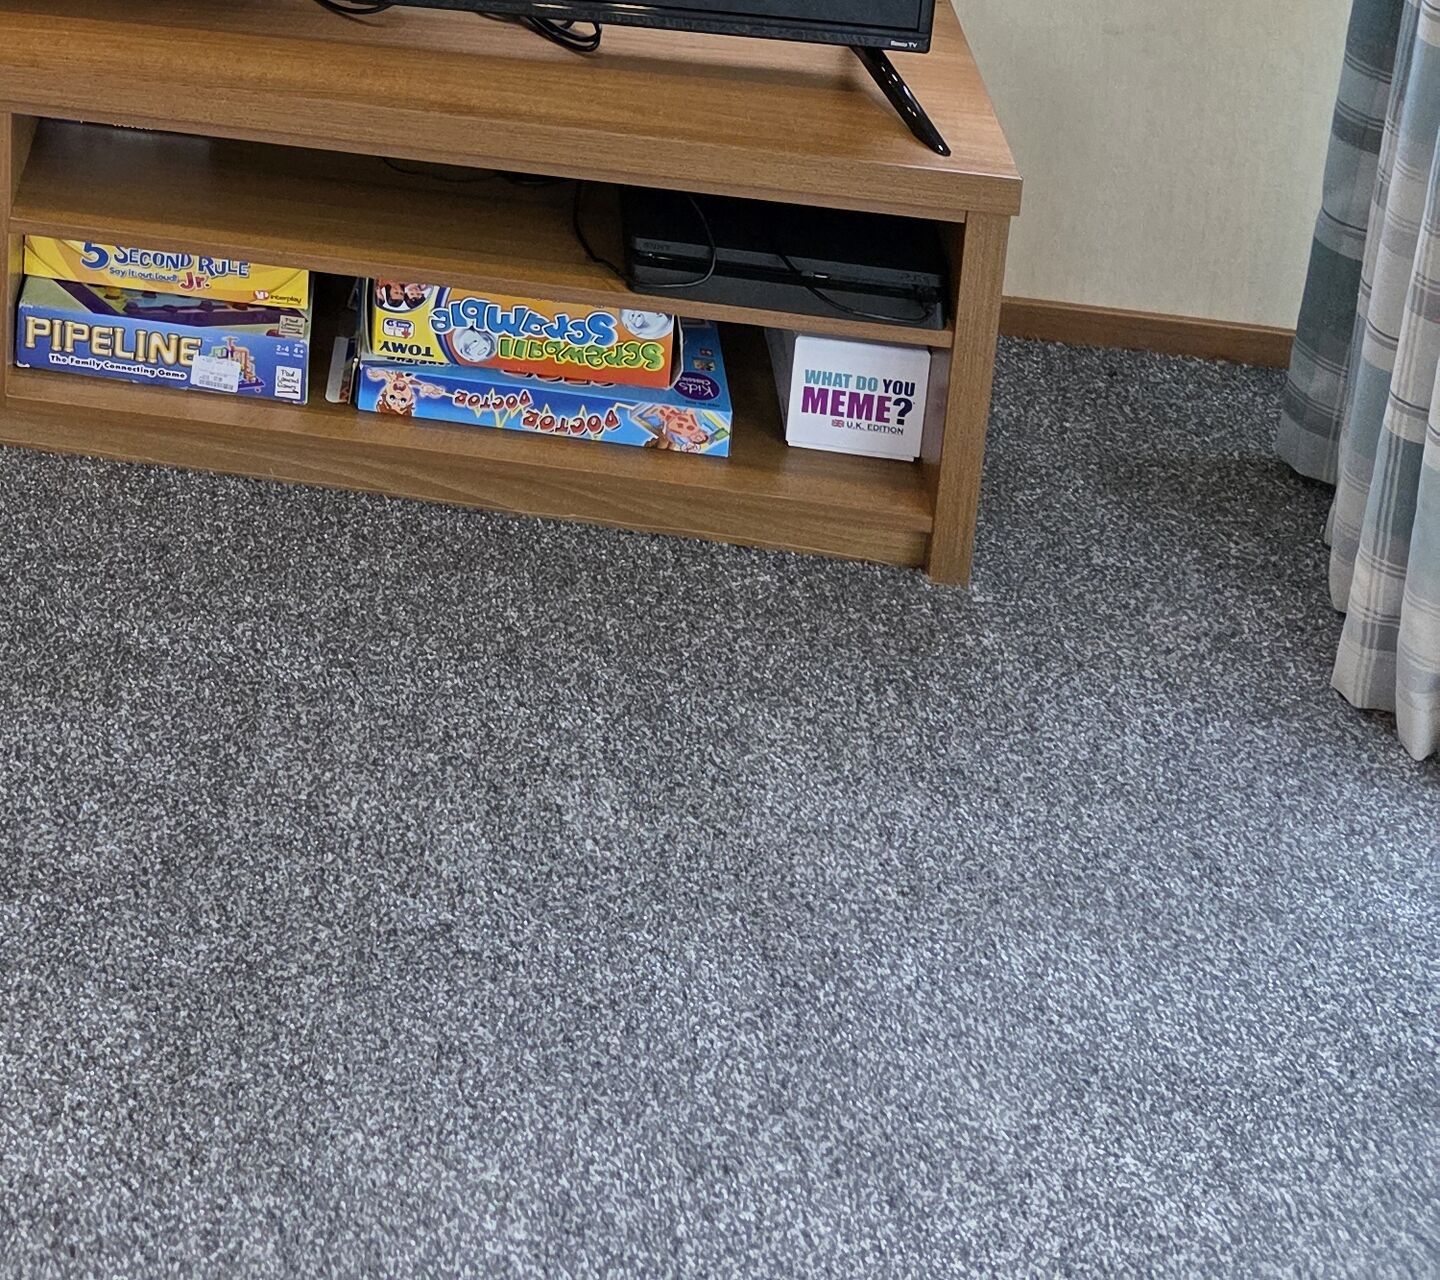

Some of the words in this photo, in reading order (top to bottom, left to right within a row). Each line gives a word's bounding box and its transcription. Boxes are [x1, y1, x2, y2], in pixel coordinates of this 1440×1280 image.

[81, 241, 109, 269] 5
[113, 244, 193, 270] SECOND
[198, 255, 251, 278] RULE
[109, 266, 126, 277] Say
[128, 268, 136, 277] it
[138, 271, 153, 279] out
[179, 271, 211, 290] Jr.
[270, 294, 302, 304] interplay
[24, 316, 203, 368] PIPELINE
[379, 340, 435, 358] TOMY
[499, 337, 664, 370] Screwball
[50, 354, 67, 363] The
[70, 356, 101, 369] Family
[104, 361, 156, 376] Connecting
[158, 368, 186, 378] Game
[678, 381, 714, 398] Kids
[804, 369, 853, 389] WHAT
[855, 375, 879, 392] DO
[883, 378, 916, 397] YOU
[453, 390, 533, 410] DOCTOR
[801, 386, 913, 426] MEME?
[523, 409, 620, 435] DOCTOR
[846, 421, 865, 432] U.K.
[867, 423, 904, 436] EDITION
